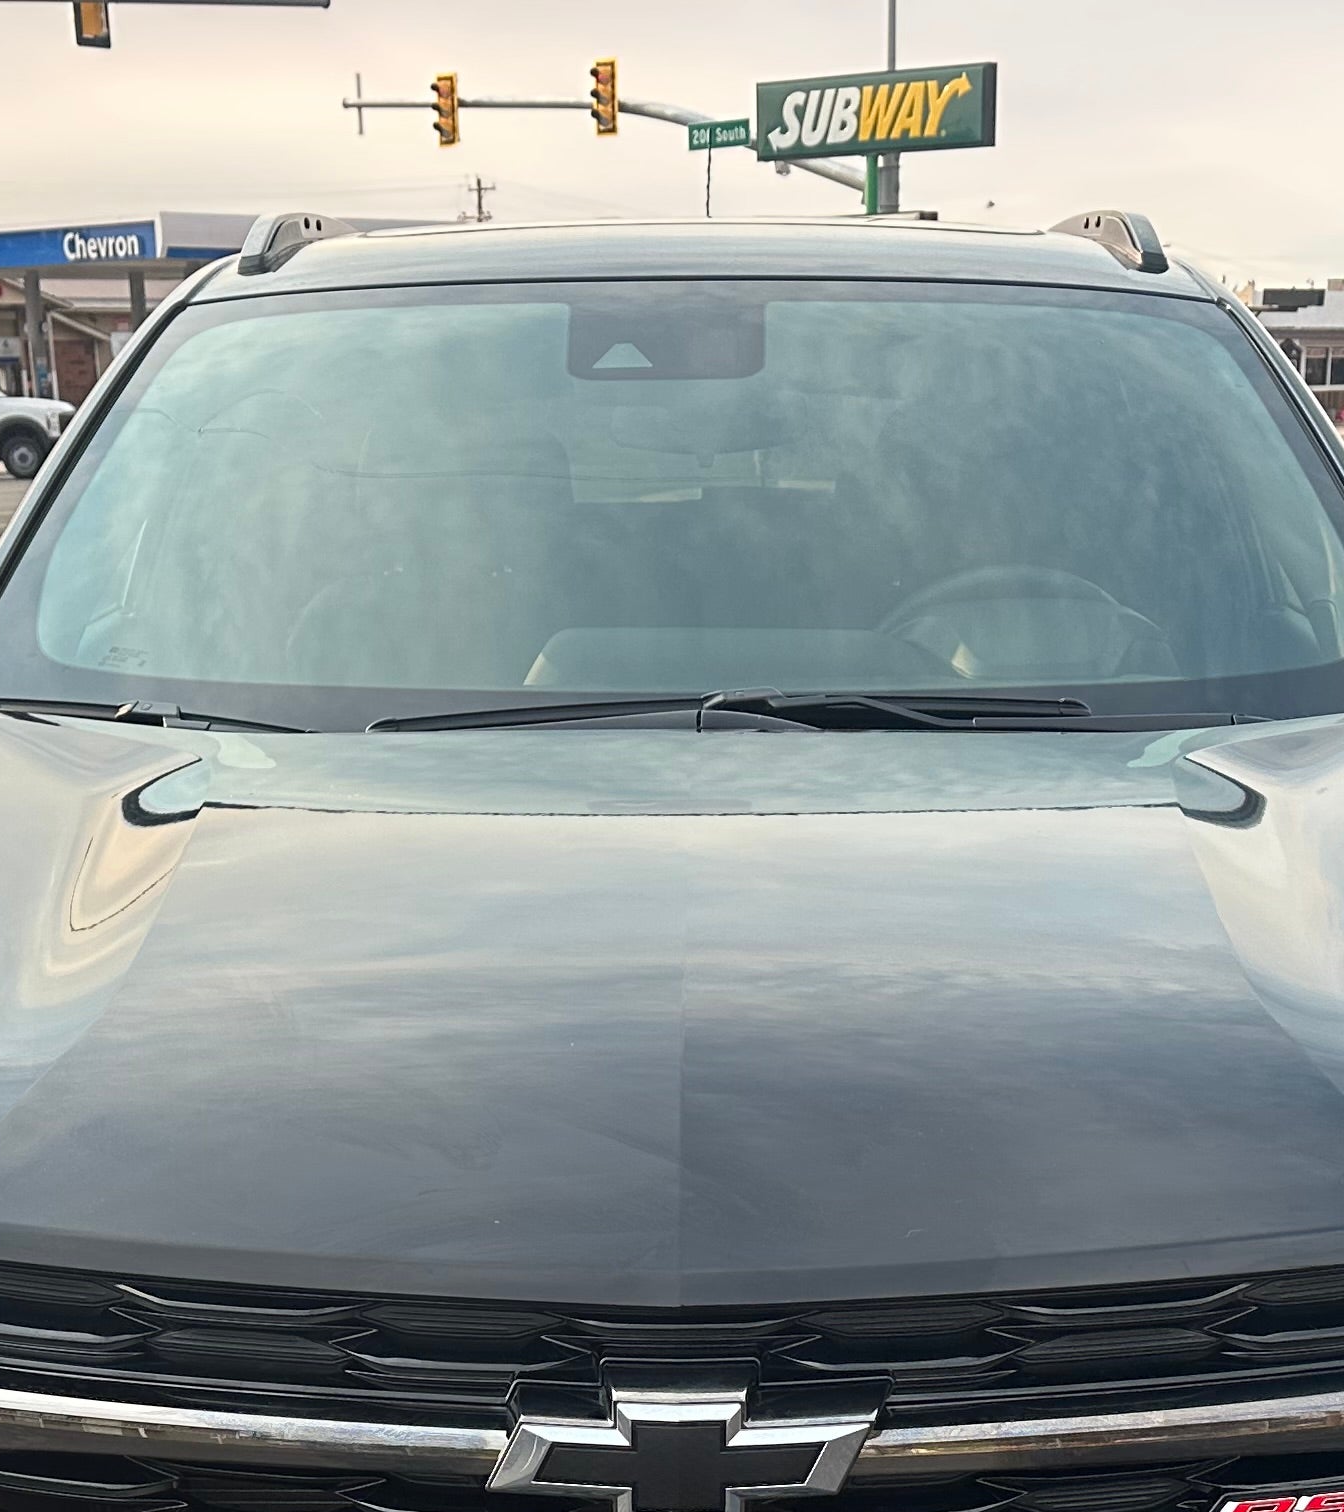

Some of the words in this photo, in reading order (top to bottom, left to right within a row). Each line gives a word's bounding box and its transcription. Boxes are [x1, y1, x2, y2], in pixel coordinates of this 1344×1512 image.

[767, 72, 972, 152] SUBWAY
[715, 126, 746, 143] South
[63, 231, 139, 261] Chevron
